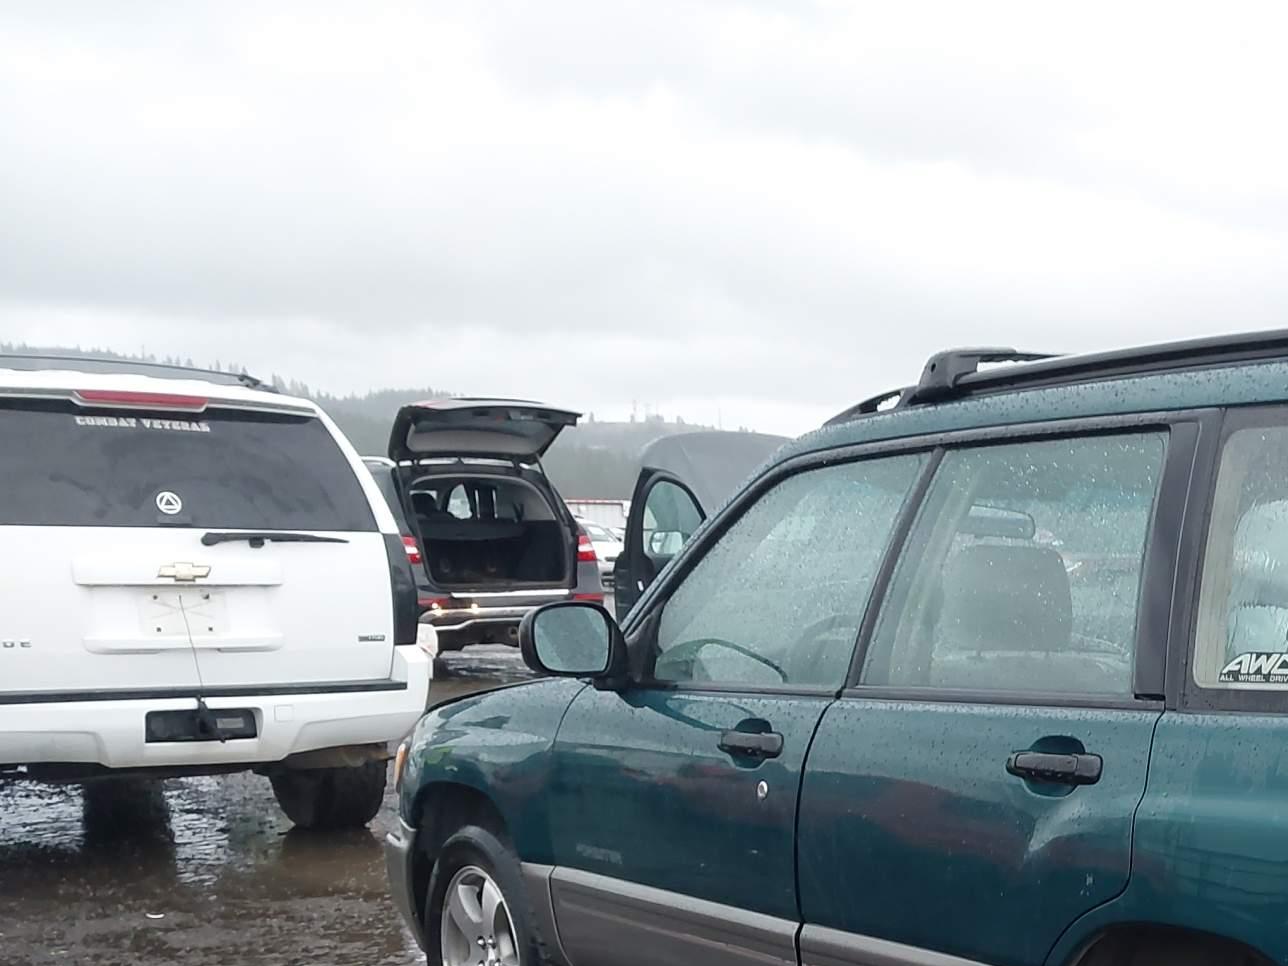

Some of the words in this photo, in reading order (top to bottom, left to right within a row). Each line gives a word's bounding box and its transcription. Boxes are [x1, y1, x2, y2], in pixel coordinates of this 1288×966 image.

[74, 415, 137, 428] COMBAT
[140, 417, 210, 432] VETERAN
[1220, 673, 1235, 682] ALL
[1238, 674, 1266, 682] WHEEL
